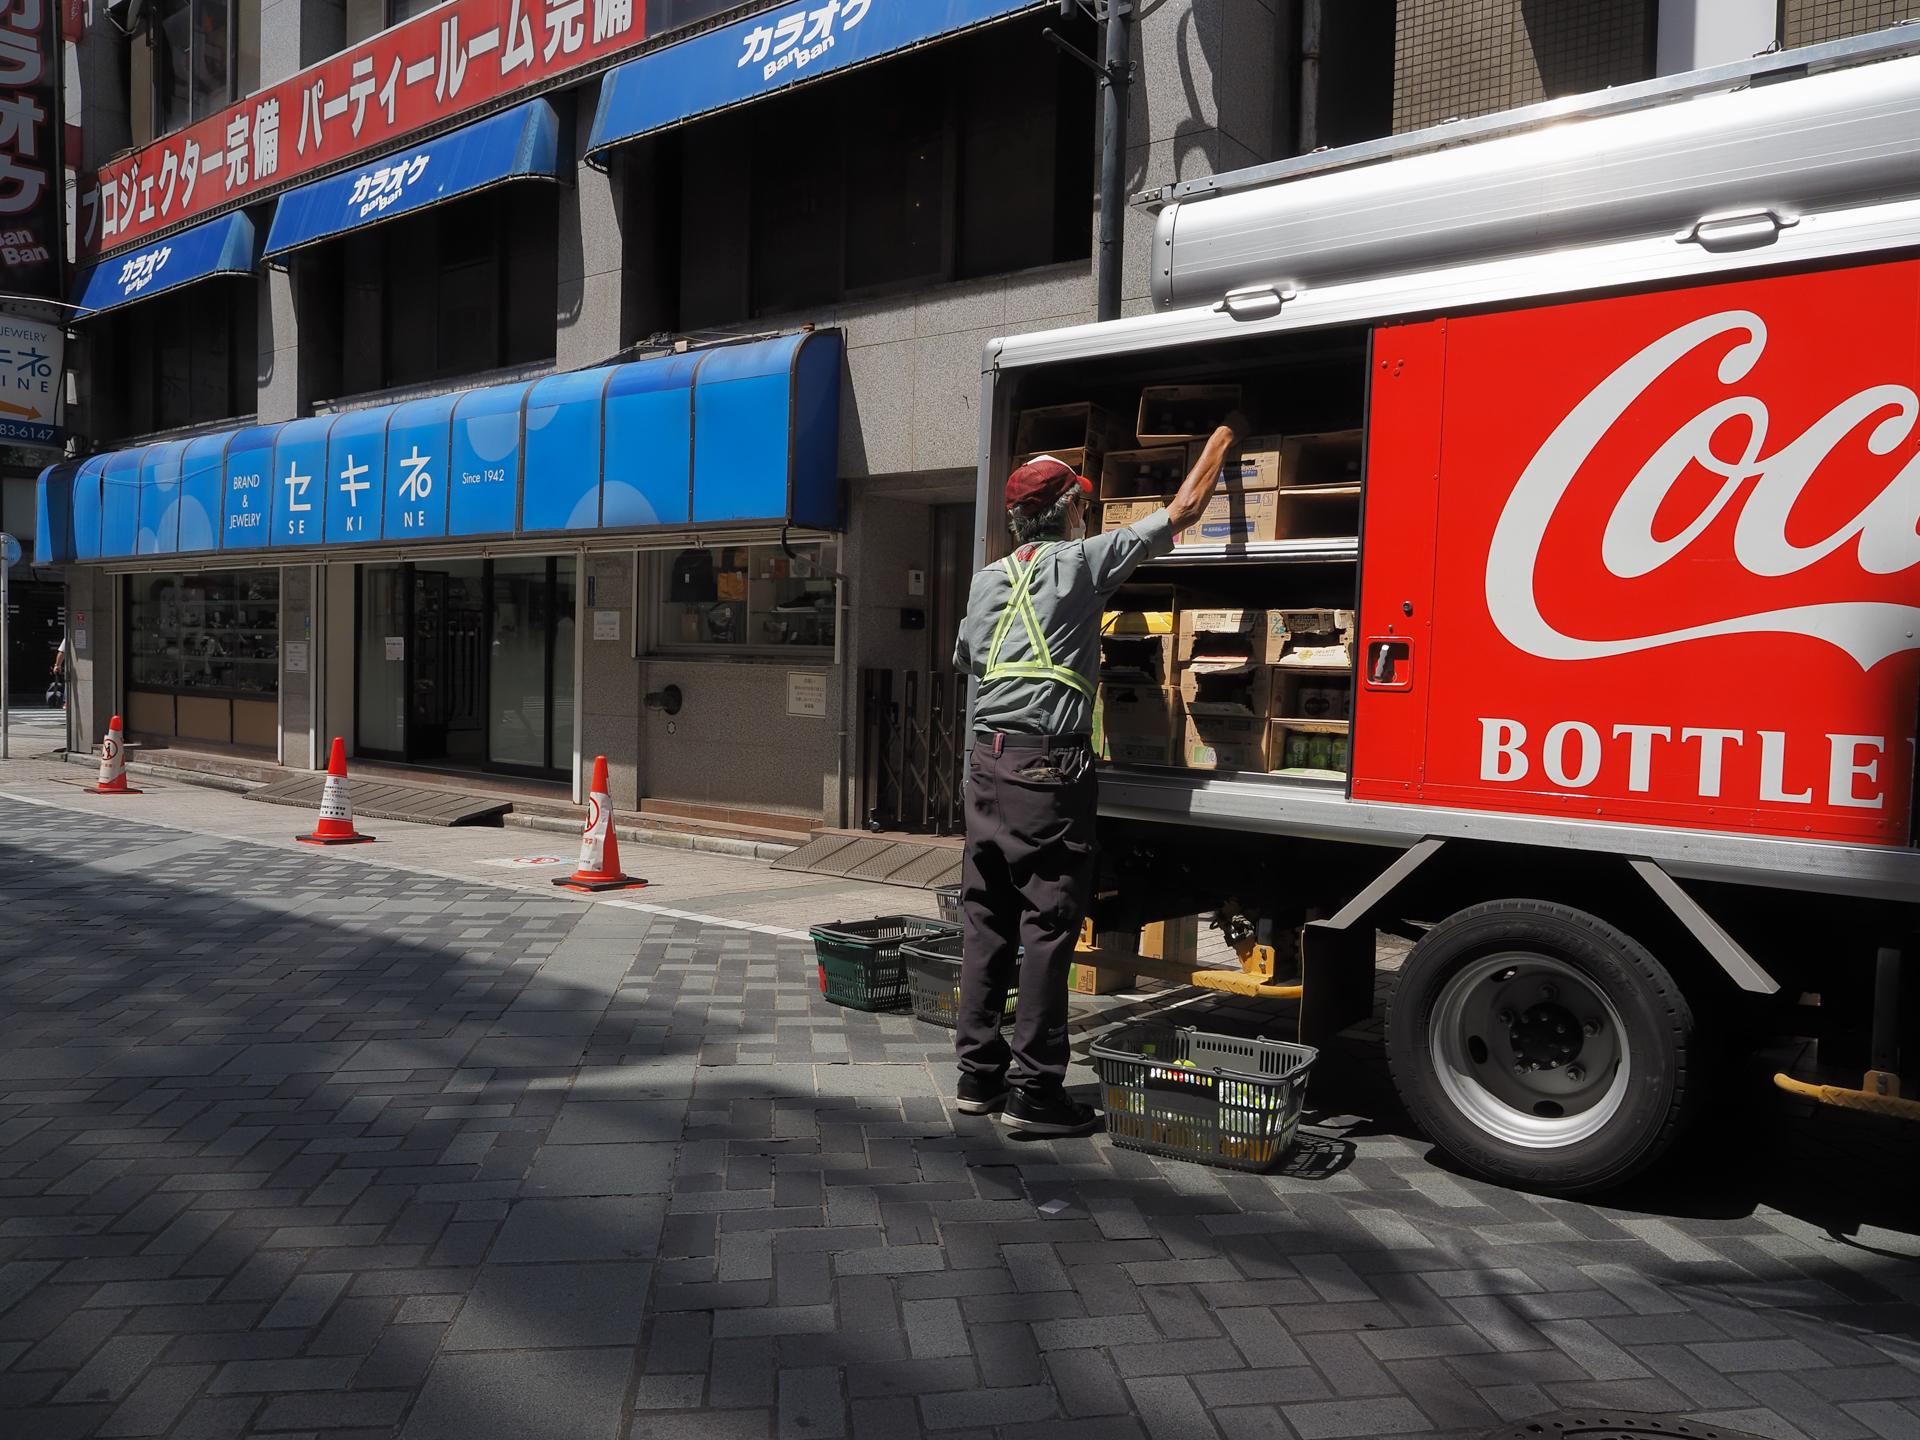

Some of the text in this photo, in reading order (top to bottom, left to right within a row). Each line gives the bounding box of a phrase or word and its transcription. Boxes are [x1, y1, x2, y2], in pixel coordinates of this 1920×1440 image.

[737, 0, 872, 68] カラオケ
[82, 98, 280, 248] プロジェクター完備
[348, 154, 430, 206] カラオケ
[0, 230, 33, 246] an
[2, 246, 49, 265] Ban
[118, 246, 172, 285] カラオケ
[0, 326, 47, 342] JEWELRY
[233, 474, 260, 490] BRAND
[285, 446, 432, 511] セキネ
[462, 469, 505, 484] Since 1942
[242, 494, 248, 508] &
[229, 512, 261, 529] JEWELRY
[288, 510, 425, 535] SE KI NE
[1478, 716, 1917, 809] BOTTLE
